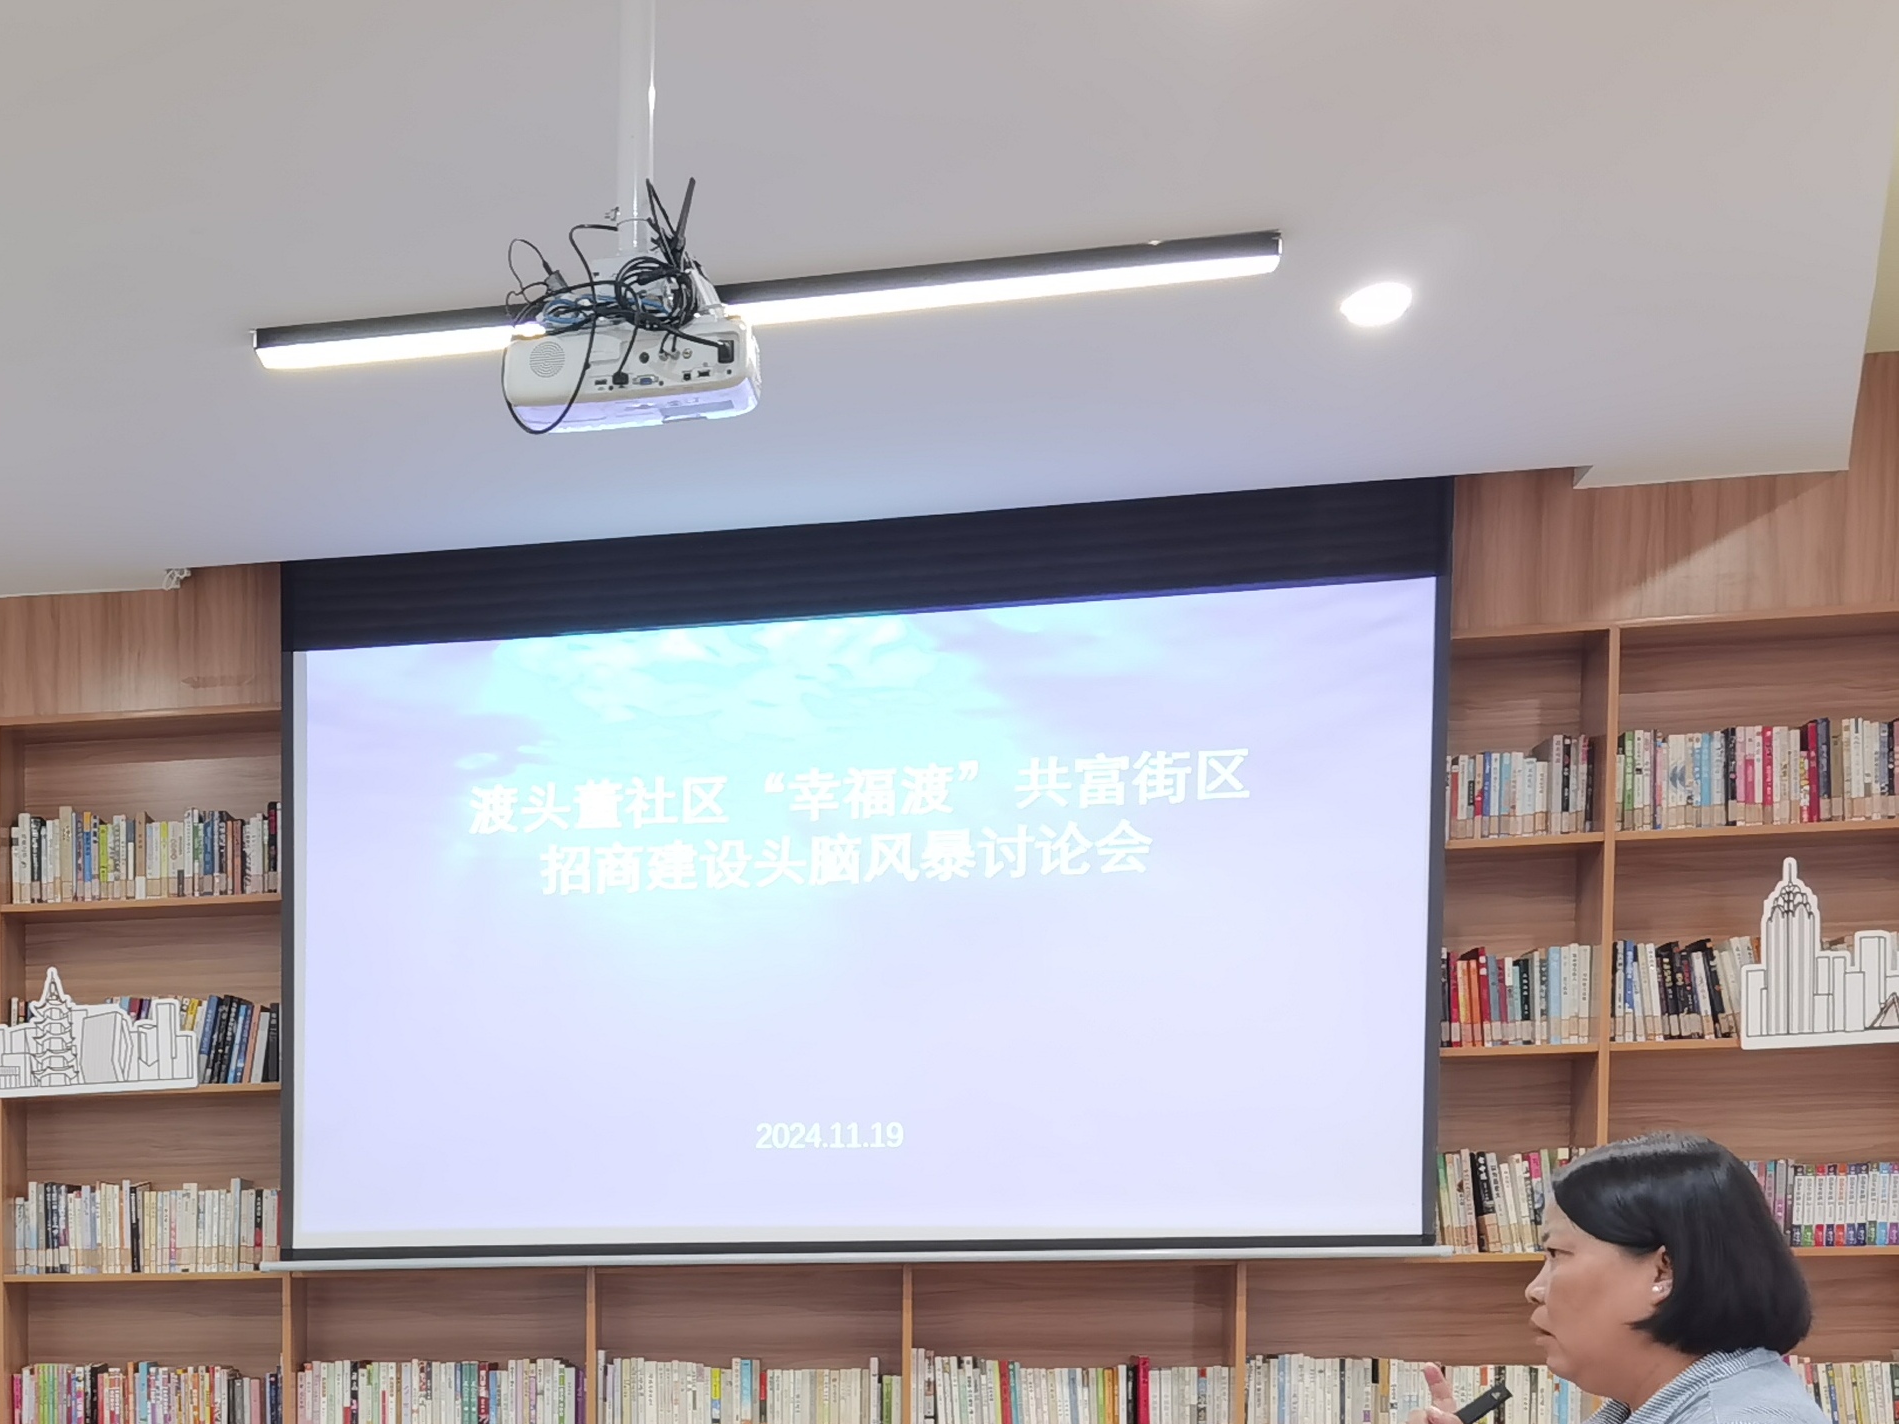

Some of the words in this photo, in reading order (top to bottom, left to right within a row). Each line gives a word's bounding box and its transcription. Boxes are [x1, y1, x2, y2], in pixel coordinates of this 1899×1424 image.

[539, 818, 1153, 895] 招商建设头脑风暴讨论会
[755, 1121, 904, 1149] 2024.11.19
